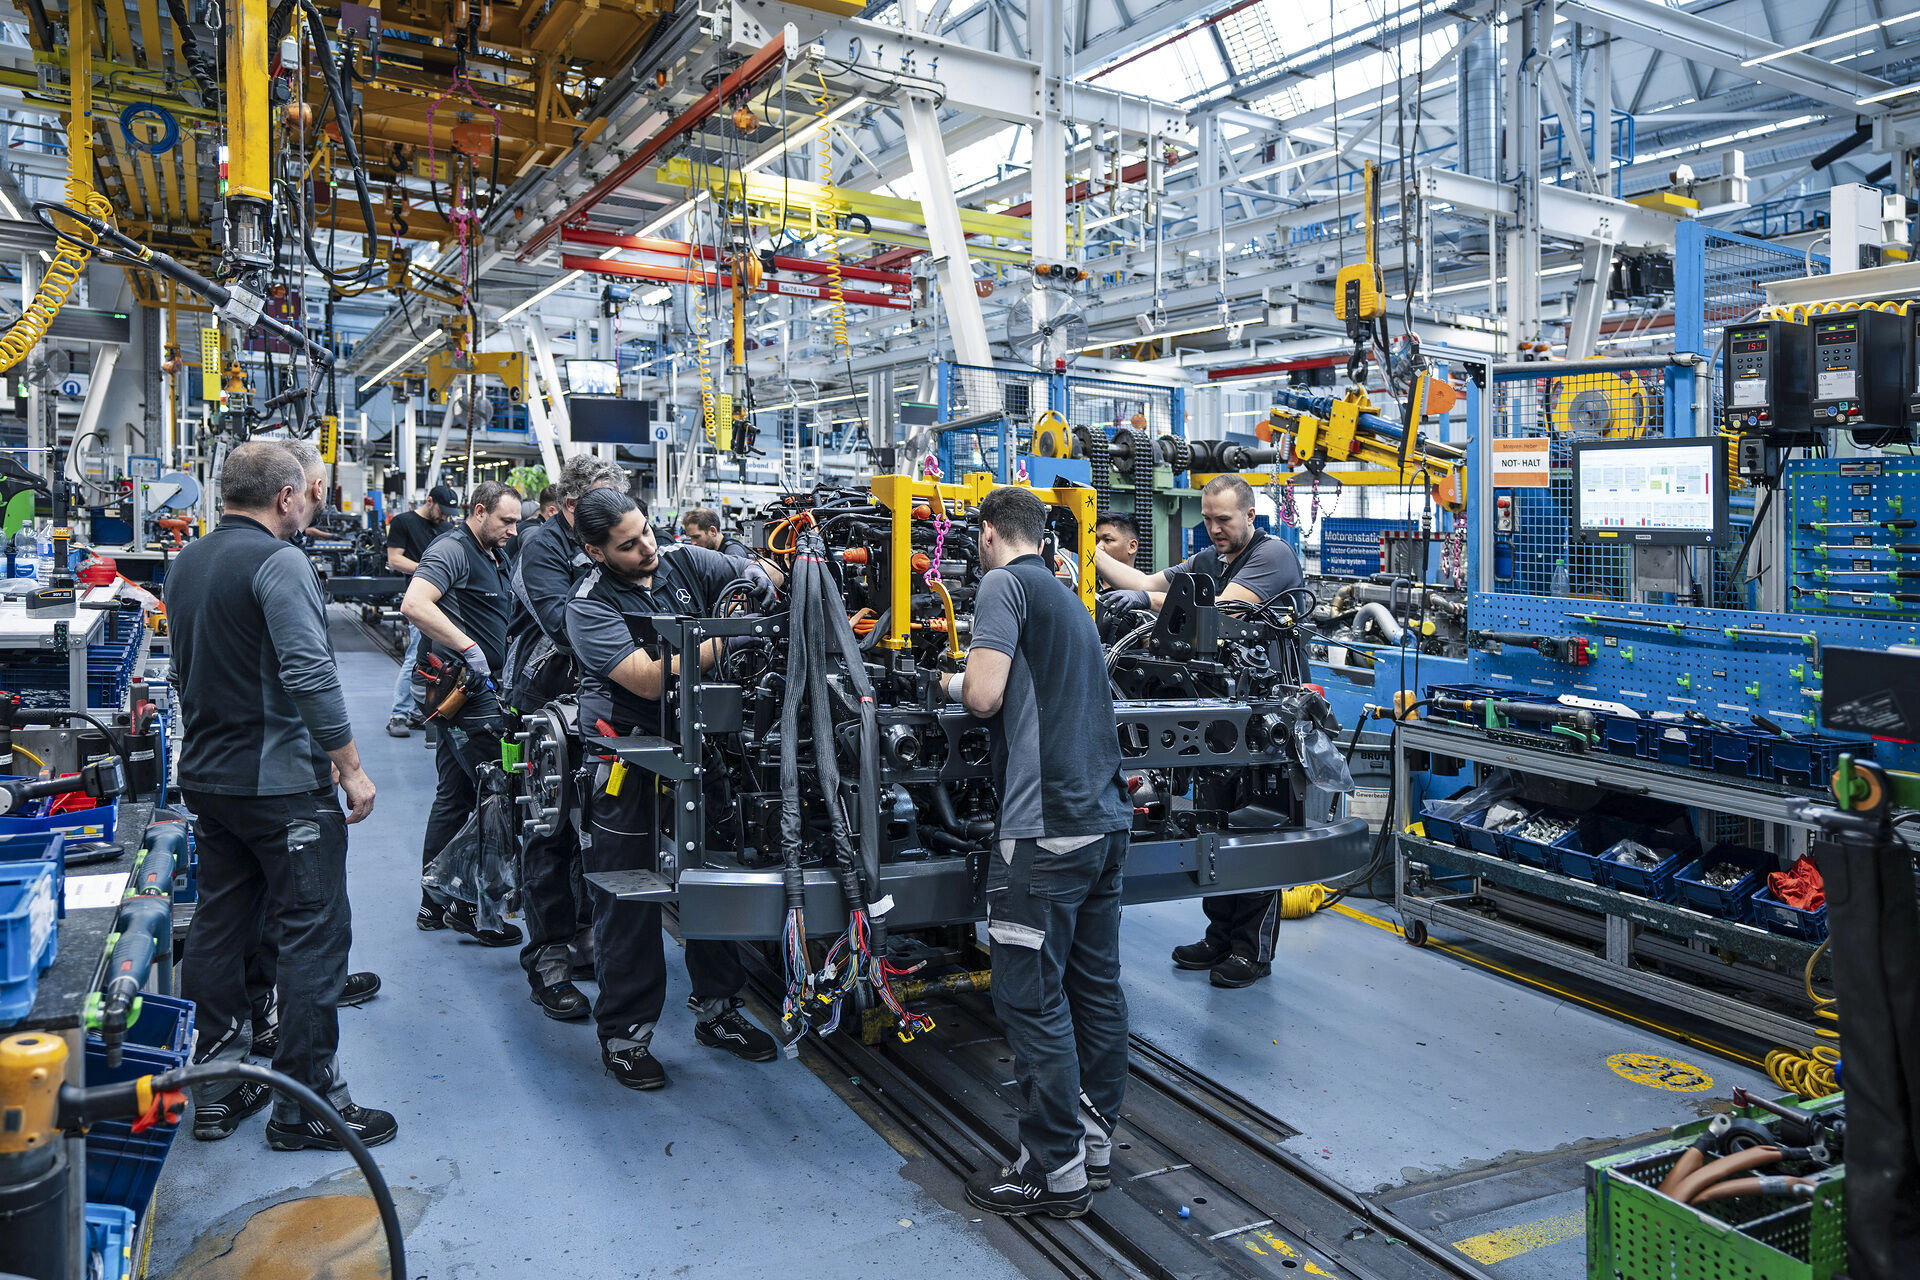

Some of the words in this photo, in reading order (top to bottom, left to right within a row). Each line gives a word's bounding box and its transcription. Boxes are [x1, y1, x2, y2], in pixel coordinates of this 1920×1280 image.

[1501, 459, 1520, 467] NOT-
[1522, 459, 1541, 467] HALT
[1324, 530, 1381, 543] Motorenstatio
